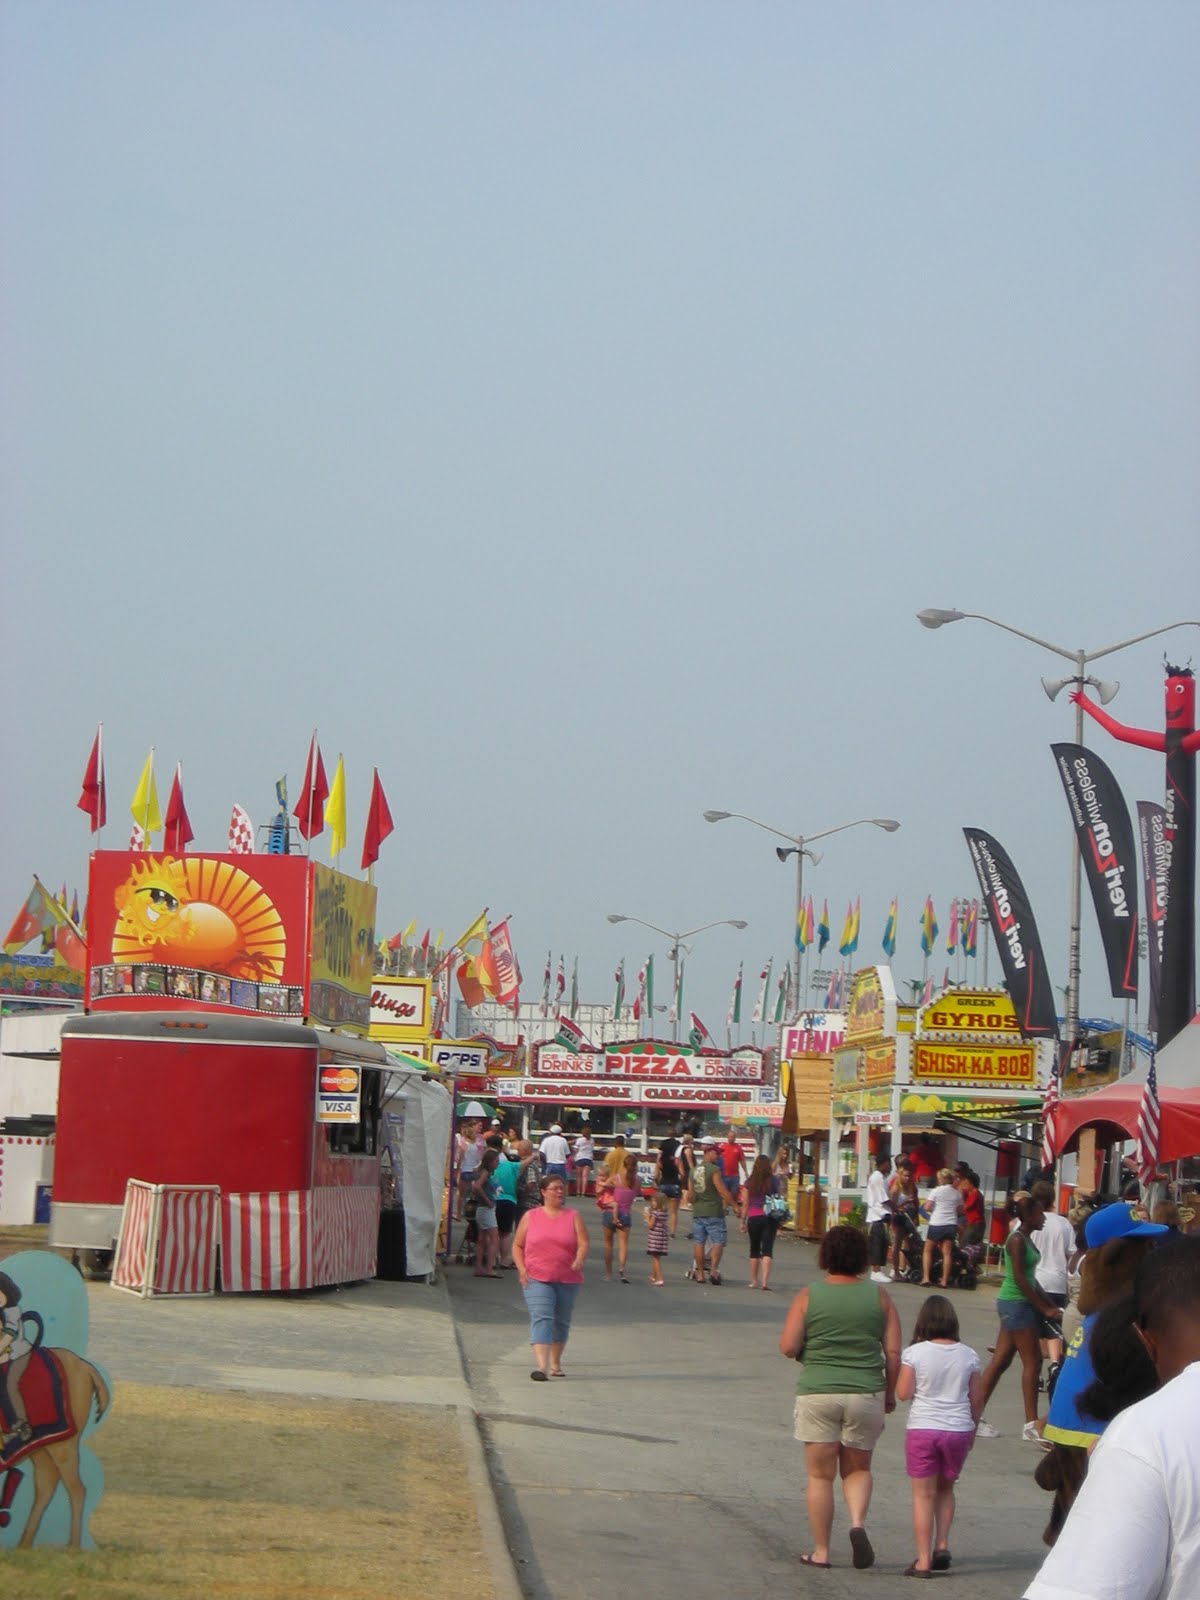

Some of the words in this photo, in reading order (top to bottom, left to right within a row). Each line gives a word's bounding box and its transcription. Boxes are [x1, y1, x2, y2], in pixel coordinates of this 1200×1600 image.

[932, 1012, 1018, 1028] GYROS
[542, 1060, 594, 1071] DRINKS
[605, 1055, 691, 1076] PIZZA
[704, 1065, 758, 1077] DRINKS
[325, 1102, 352, 1112] VISA
[739, 1106, 783, 1116] FUNNEL
